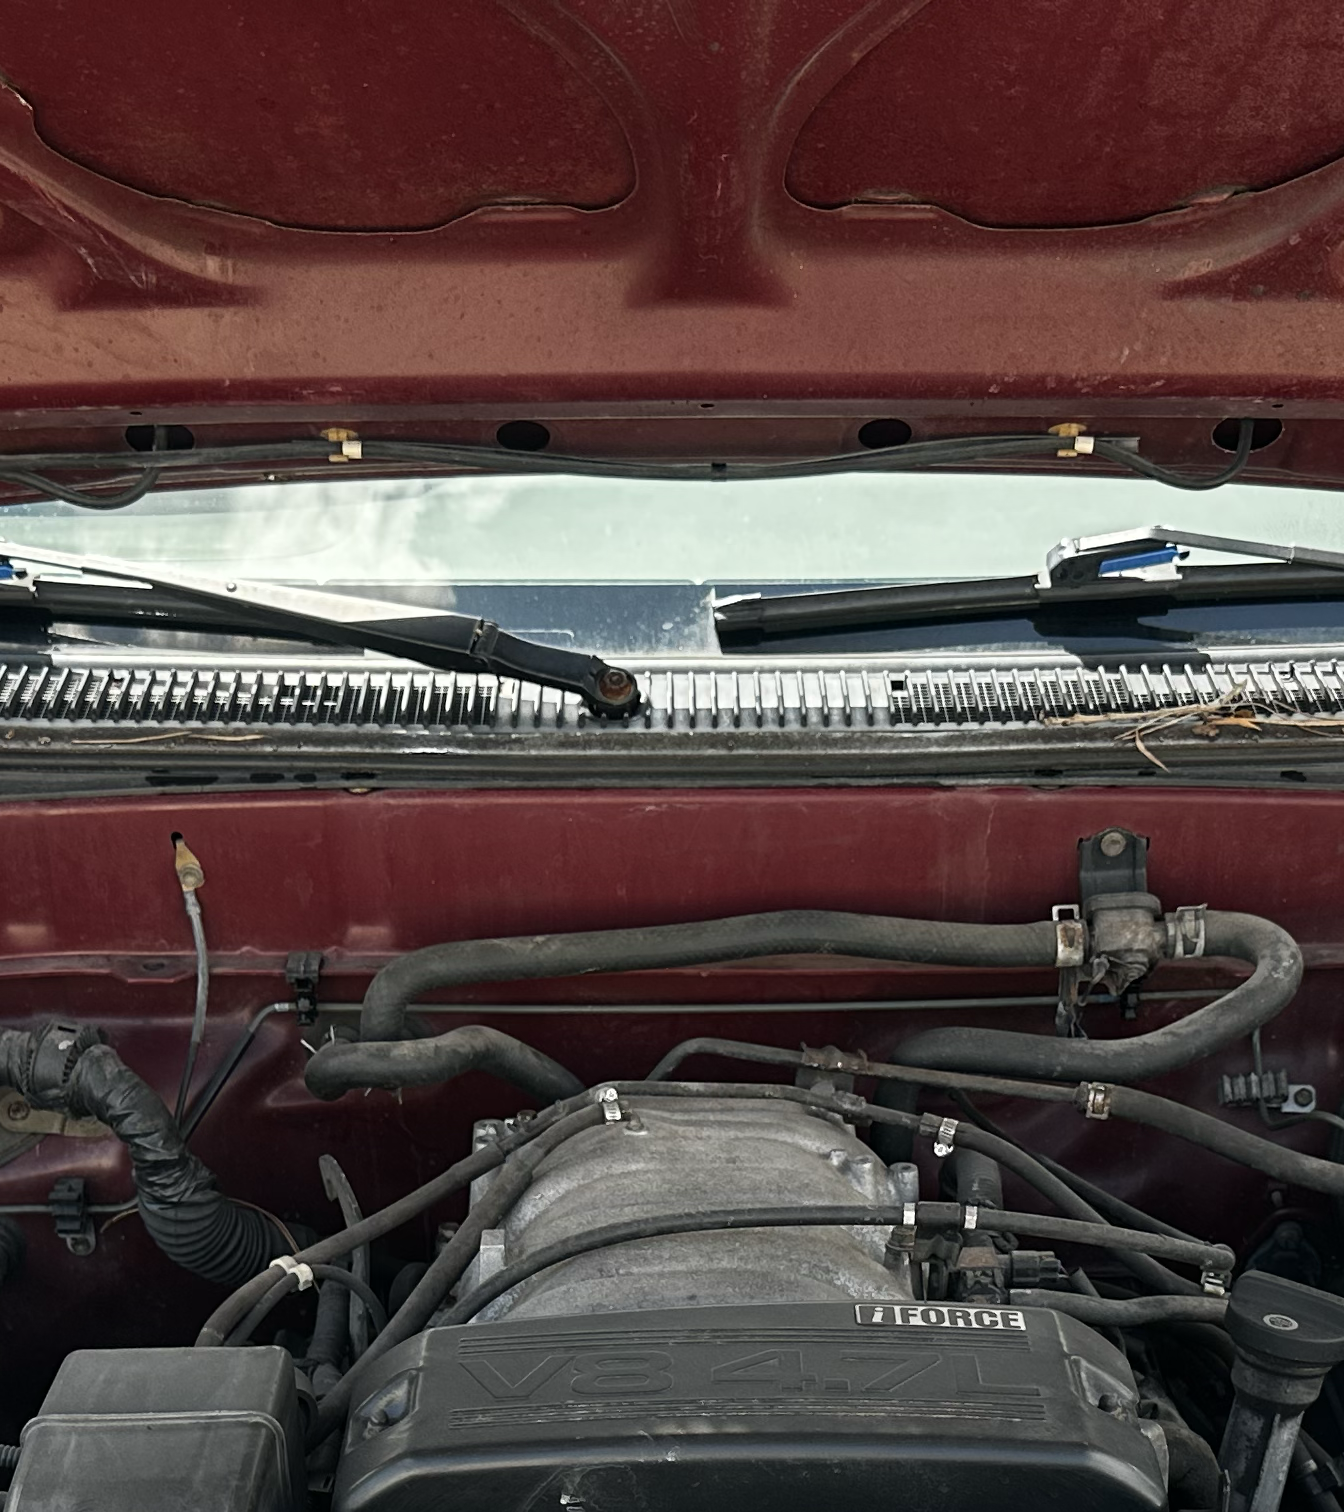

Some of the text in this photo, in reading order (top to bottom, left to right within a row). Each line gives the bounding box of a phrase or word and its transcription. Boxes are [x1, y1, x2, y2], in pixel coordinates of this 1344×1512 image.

[899, 1307, 1022, 1329] FORCE
[458, 1348, 1042, 1399] V8 4.7L
